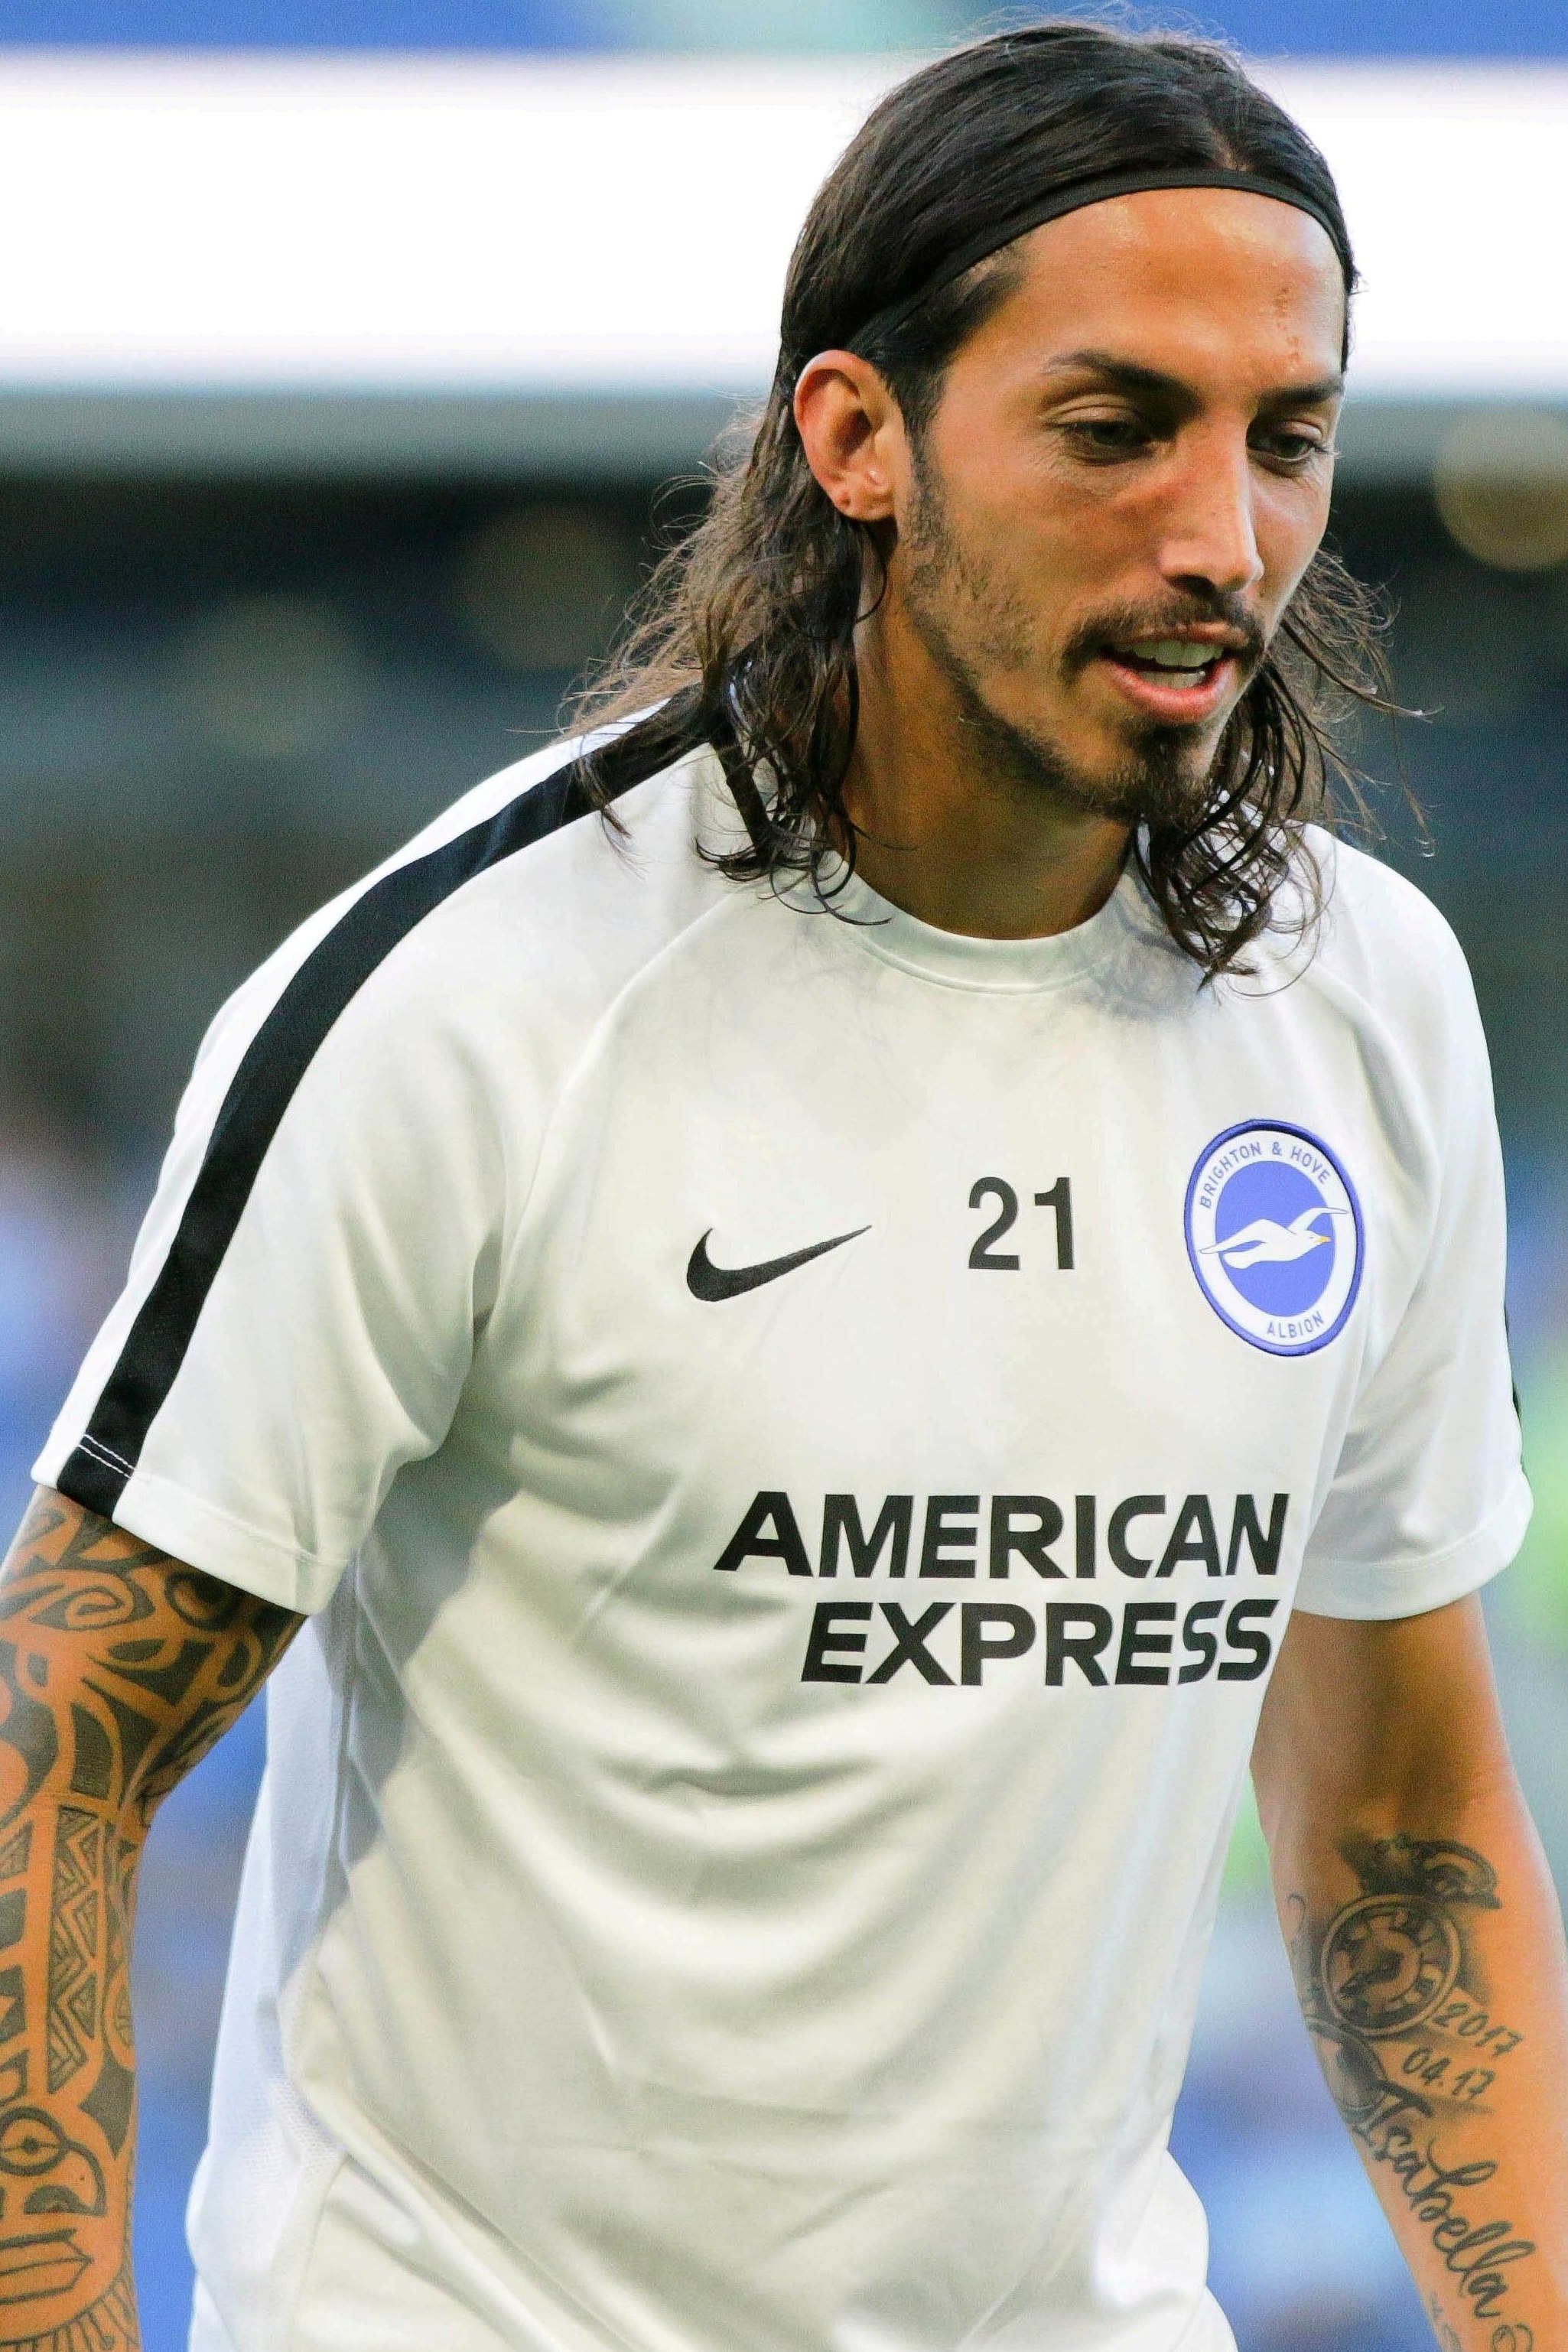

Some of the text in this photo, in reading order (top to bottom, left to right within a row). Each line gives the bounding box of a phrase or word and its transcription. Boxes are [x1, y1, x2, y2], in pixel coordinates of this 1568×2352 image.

[1199, 1140, 1331, 1209] BRIGHTON & HOVE
[968, 1176, 1075, 1270] 21
[1266, 1309, 1326, 1339] ALBION
[713, 1490, 1290, 1579] AMERICAN
[800, 1599, 1281, 1686] EXPRESS
[1431, 2002, 1524, 2058] 2017
